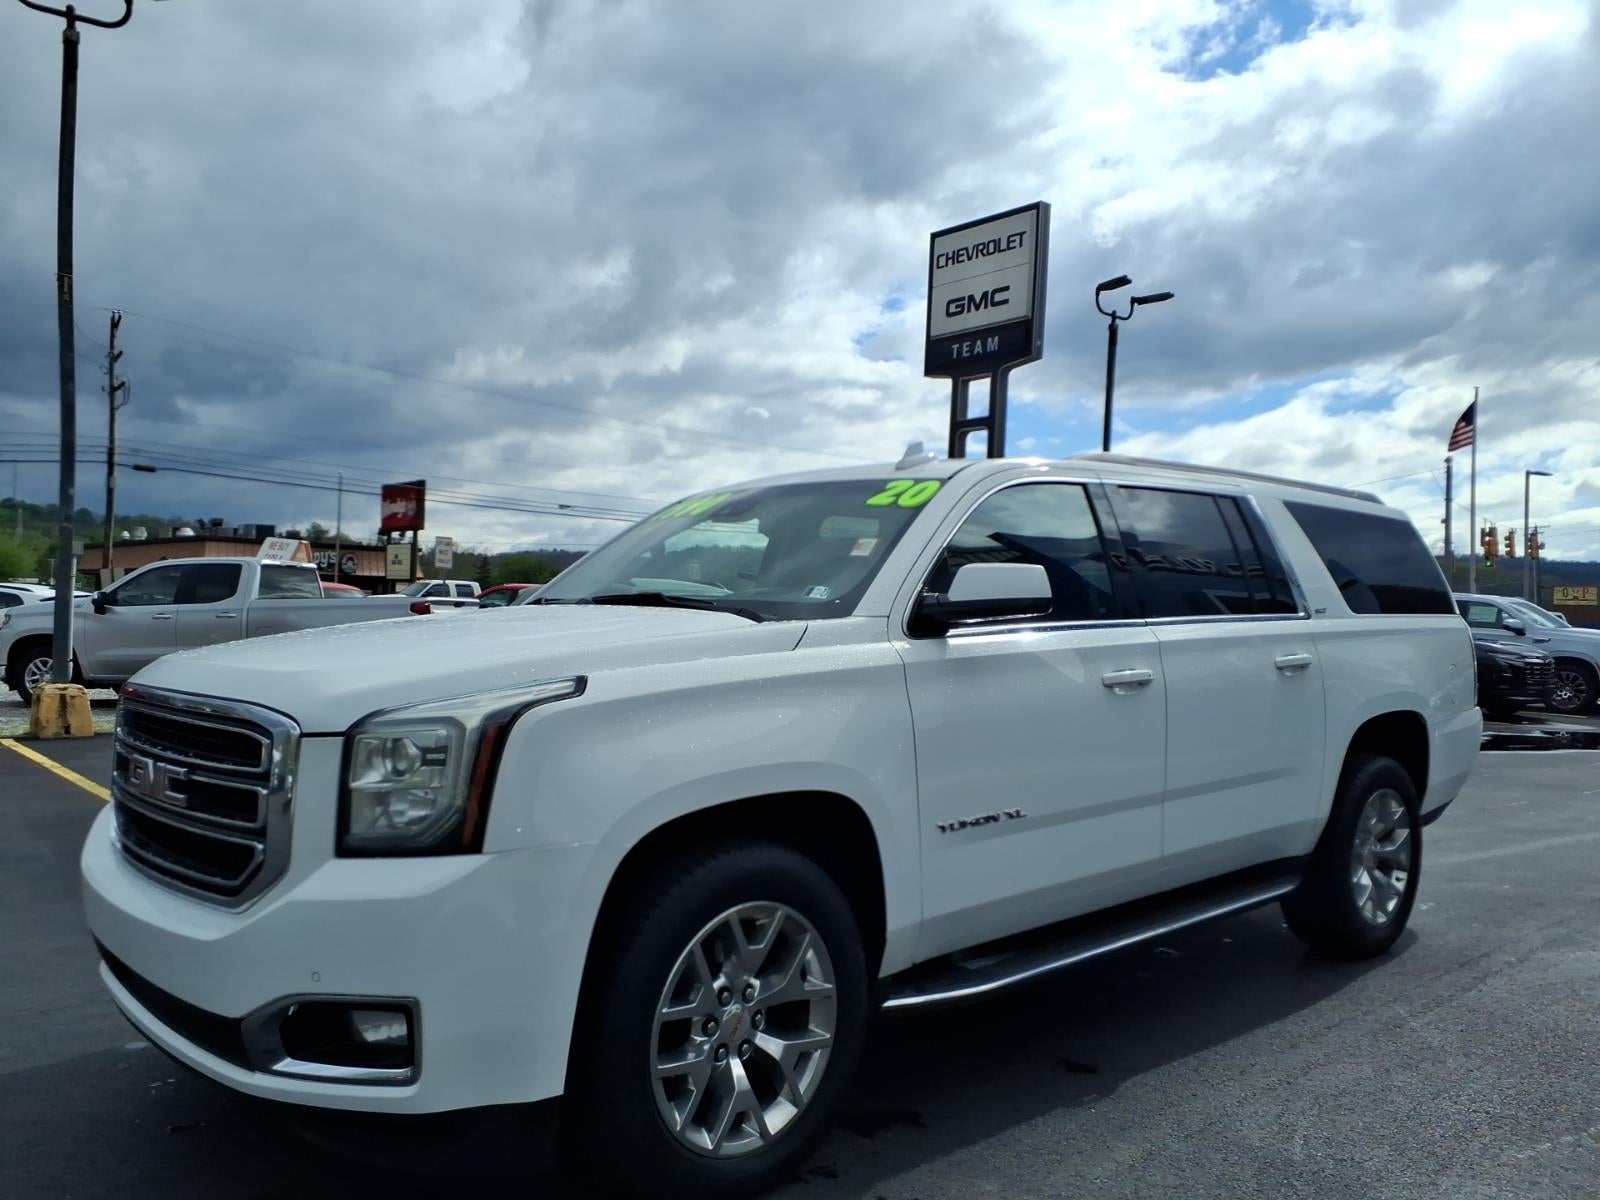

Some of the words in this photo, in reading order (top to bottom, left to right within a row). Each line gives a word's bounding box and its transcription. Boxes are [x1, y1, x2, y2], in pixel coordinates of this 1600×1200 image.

[936, 230, 1027, 270] CHEVROLET
[945, 285, 1010, 318] GMC
[952, 336, 999, 359] TEAM
[866, 480, 941, 508] 20
[129, 753, 189, 808] GMC
[936, 812, 1000, 834] YUKON
[1003, 807, 1028, 819] XL
